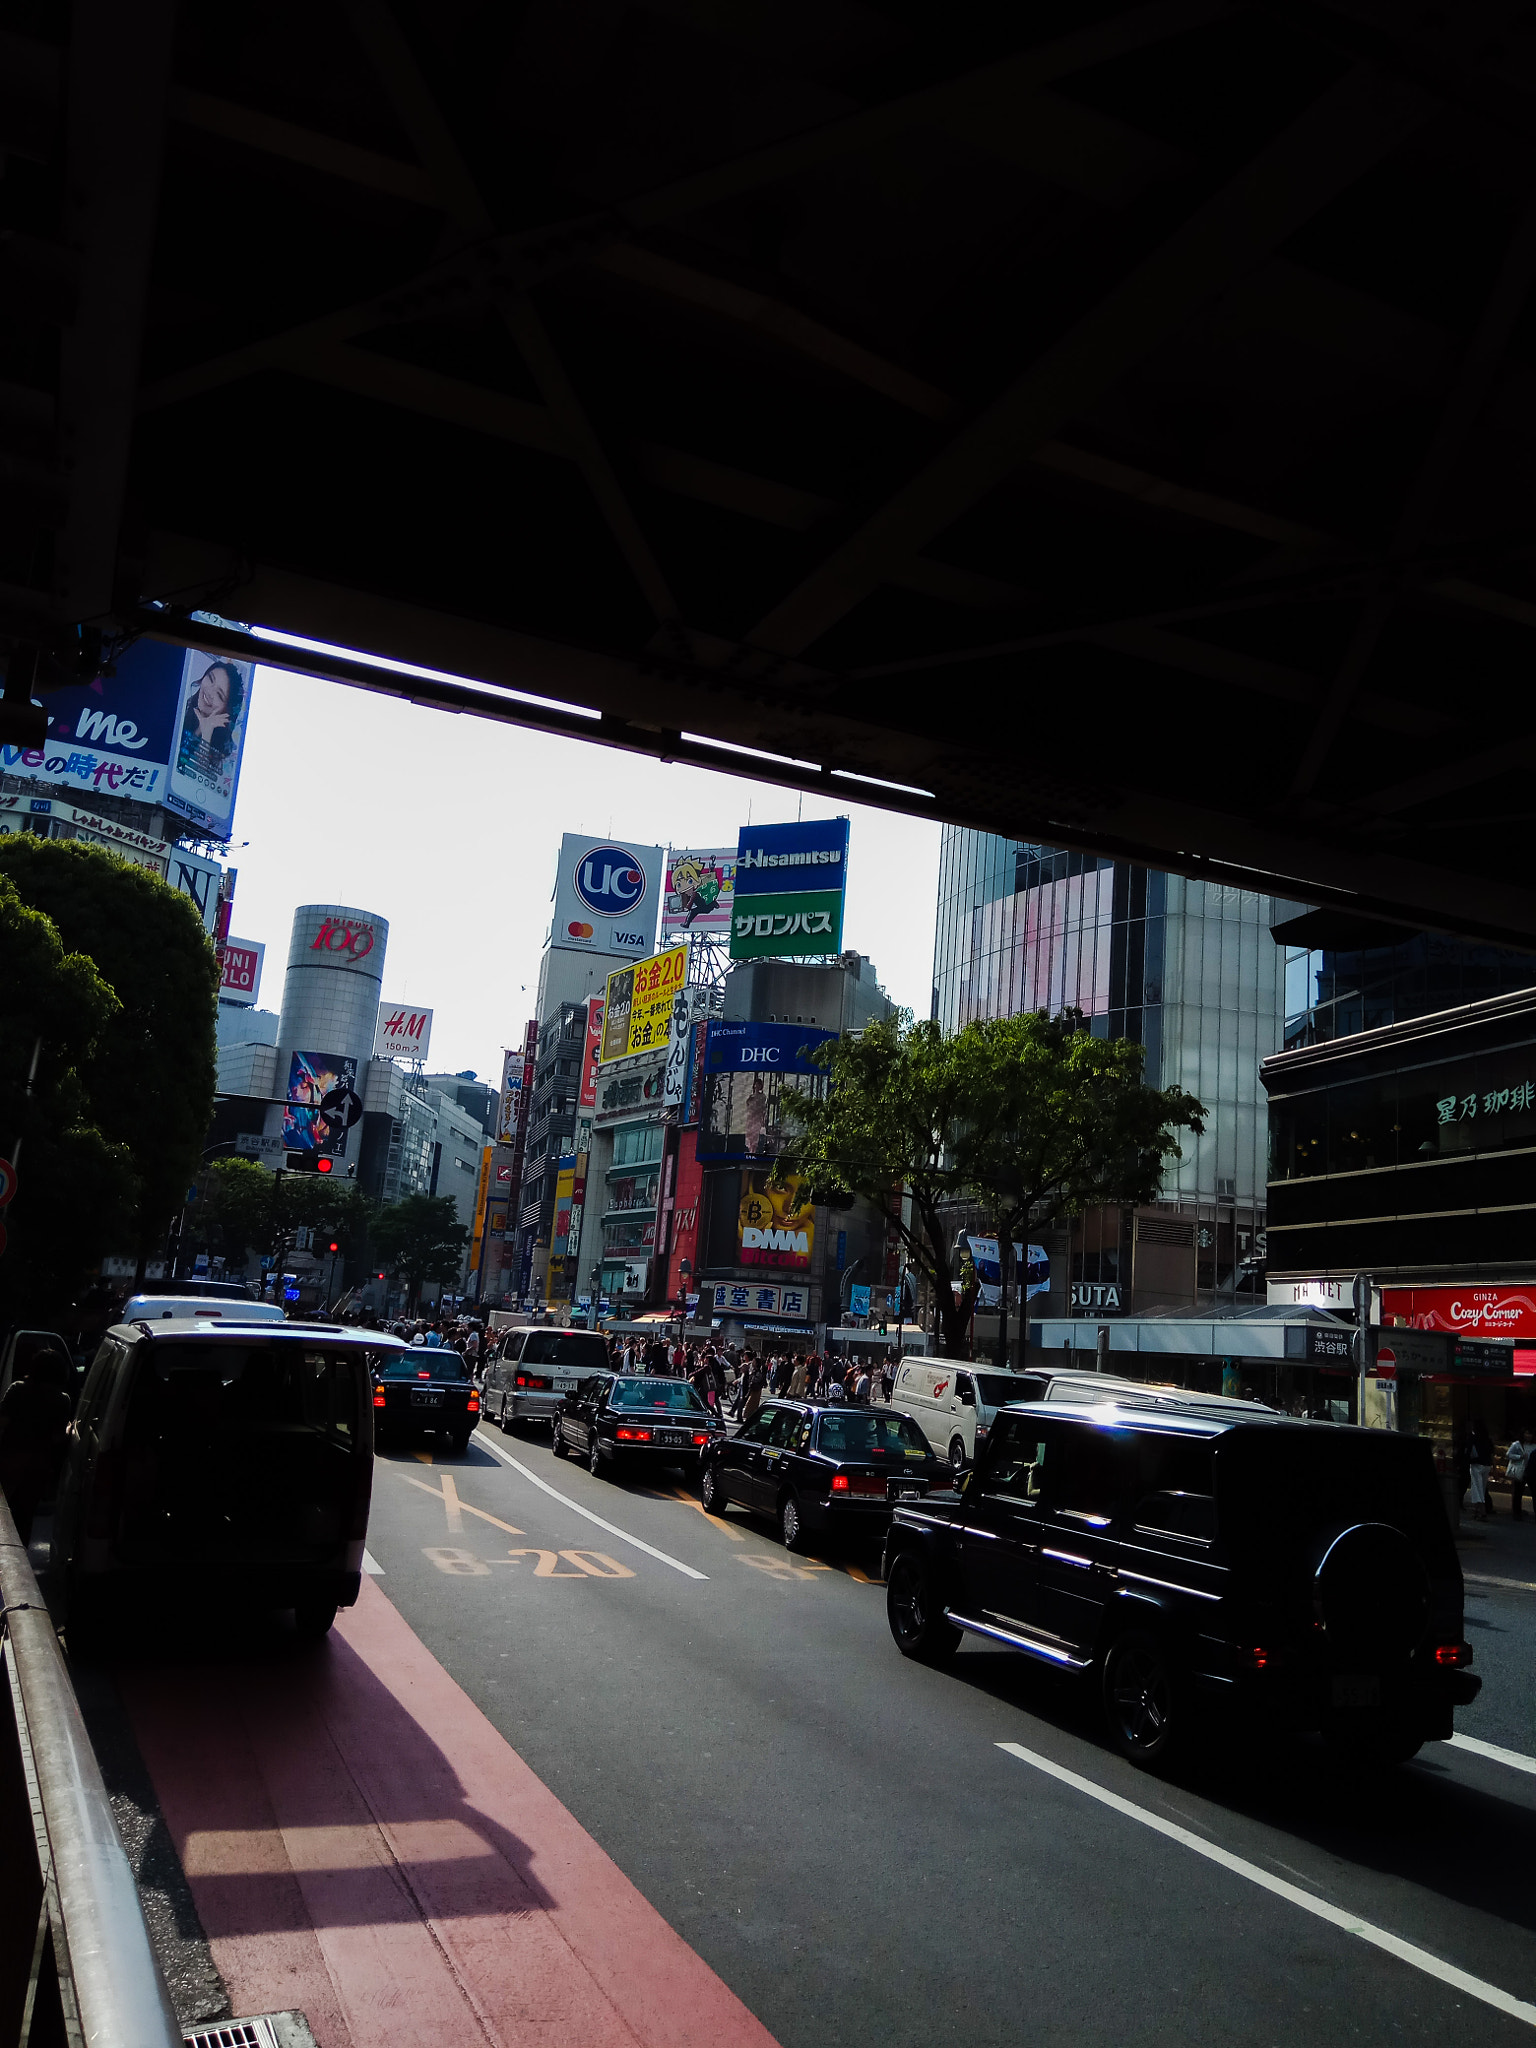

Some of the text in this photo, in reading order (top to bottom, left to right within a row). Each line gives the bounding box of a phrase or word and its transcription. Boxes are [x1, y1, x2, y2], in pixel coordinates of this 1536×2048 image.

[75, 707, 149, 750] me
[737, 849, 842, 869] Hisamitsu
[325, 916, 375, 934] SHIBUYA
[734, 910, 833, 938] サロンパス
[309, 924, 375, 963] 109
[614, 931, 646, 948] VISA
[635, 951, 684, 994] お金2.0
[384, 1010, 427, 1040] H&M
[740, 1047, 780, 1063] DHC
[1436, 1079, 1536, 1125] 星乃珈琲
[741, 1226, 809, 1253] DMM
[741, 1247, 808, 1268] Bitcoin
[714, 1286, 803, 1313] 盛堂書店
[1071, 1285, 1123, 1307] SUTA
[1473, 1293, 1498, 1301] GINZA
[1450, 1301, 1524, 1327] Cozy Corner
[1314, 1341, 1348, 1356] 渋谷駅
